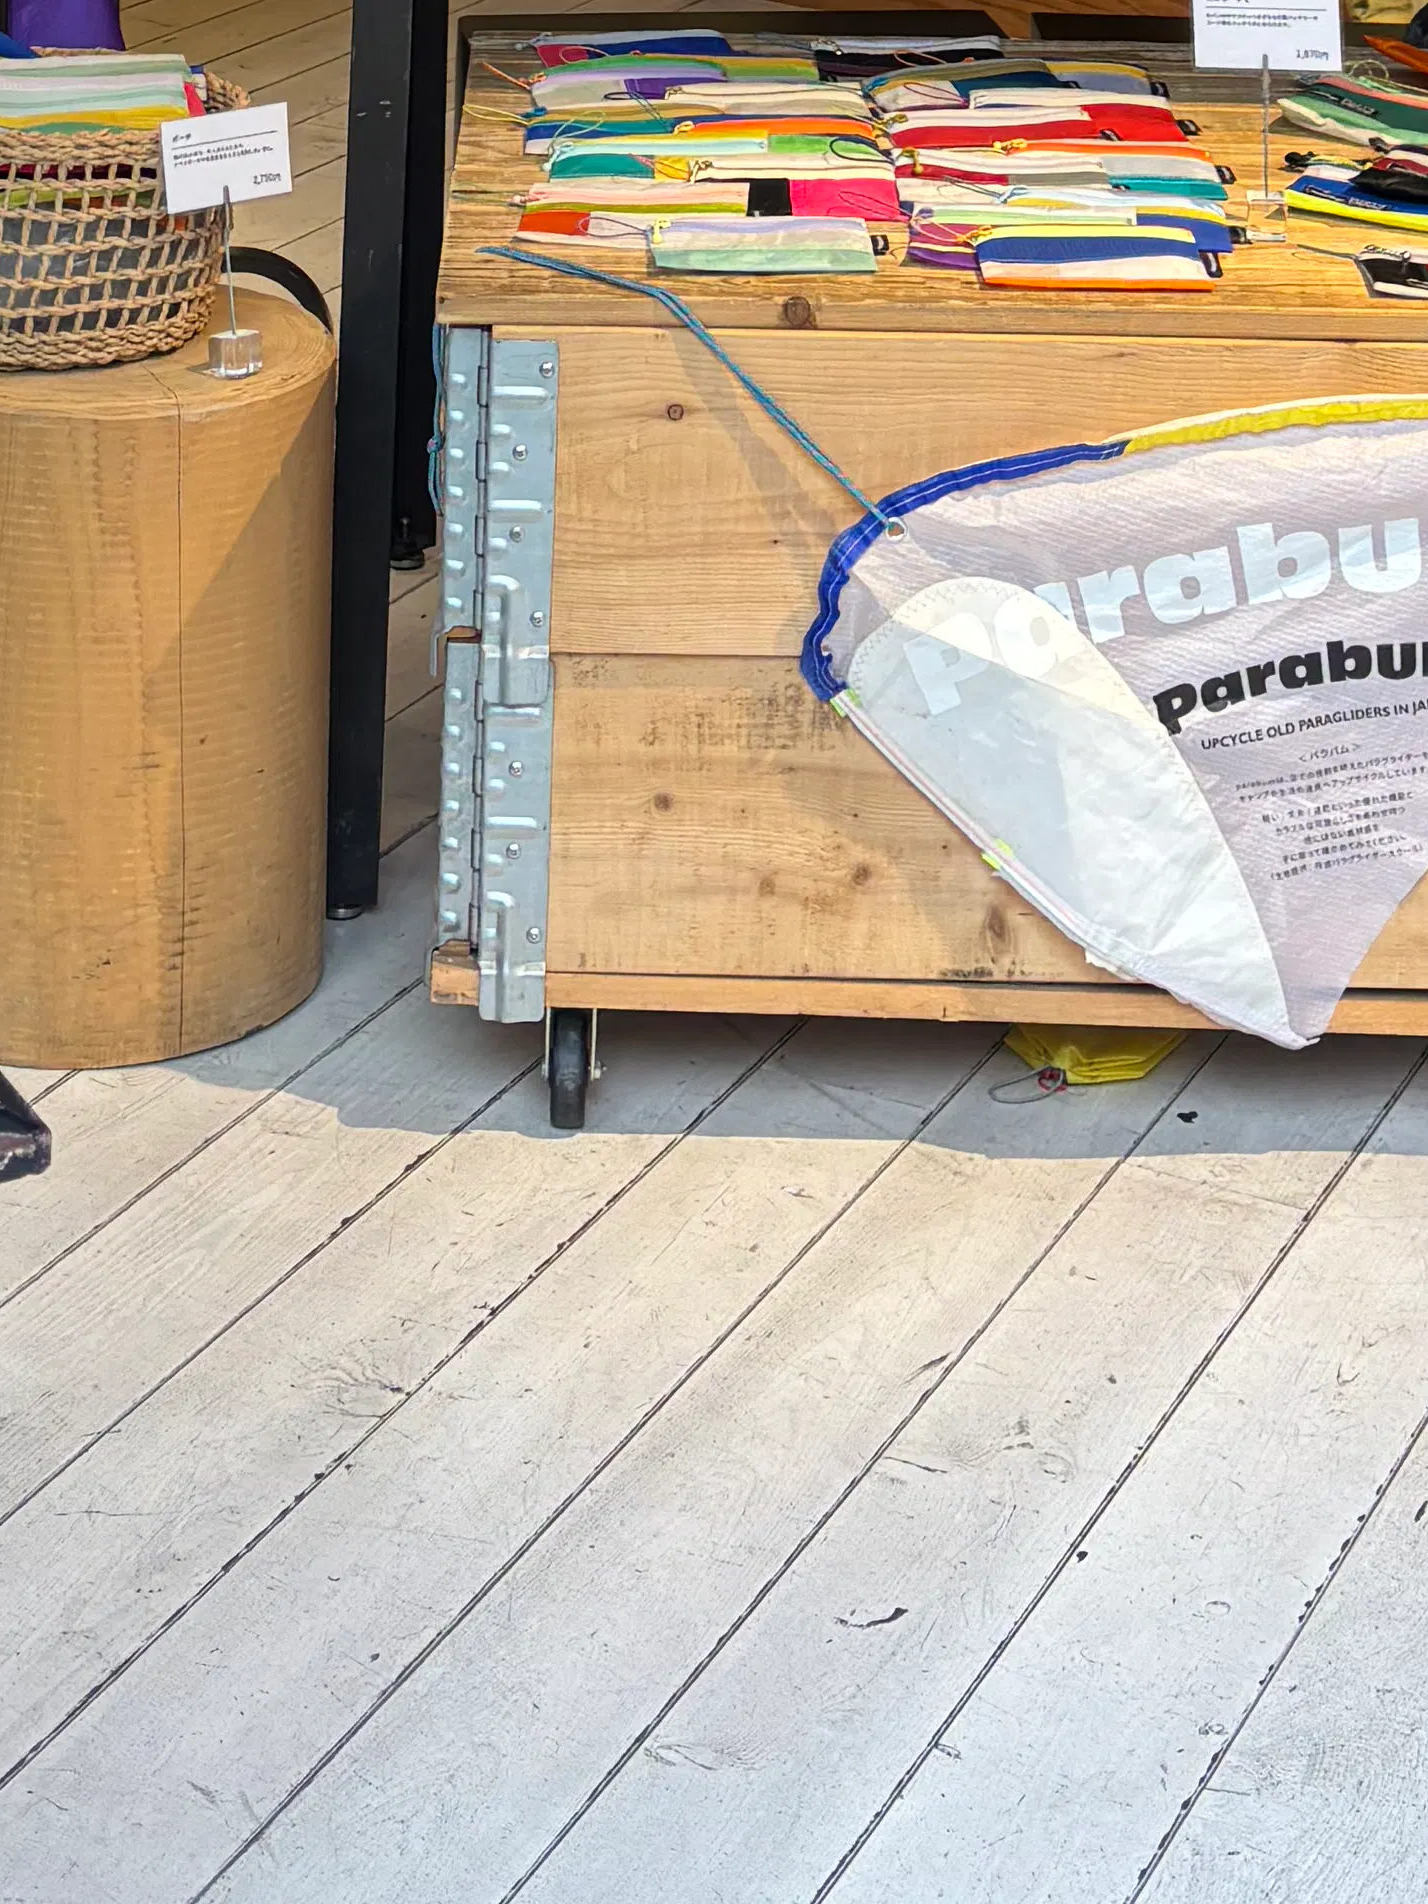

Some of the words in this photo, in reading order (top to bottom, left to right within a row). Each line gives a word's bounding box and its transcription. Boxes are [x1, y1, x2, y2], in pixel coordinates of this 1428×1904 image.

[1201, 729, 1264, 750] UPCYCLE
[1266, 721, 1296, 739] OLD
[1298, 706, 1390, 732] PARAGLIDERS
[1393, 701, 1410, 716] IN
